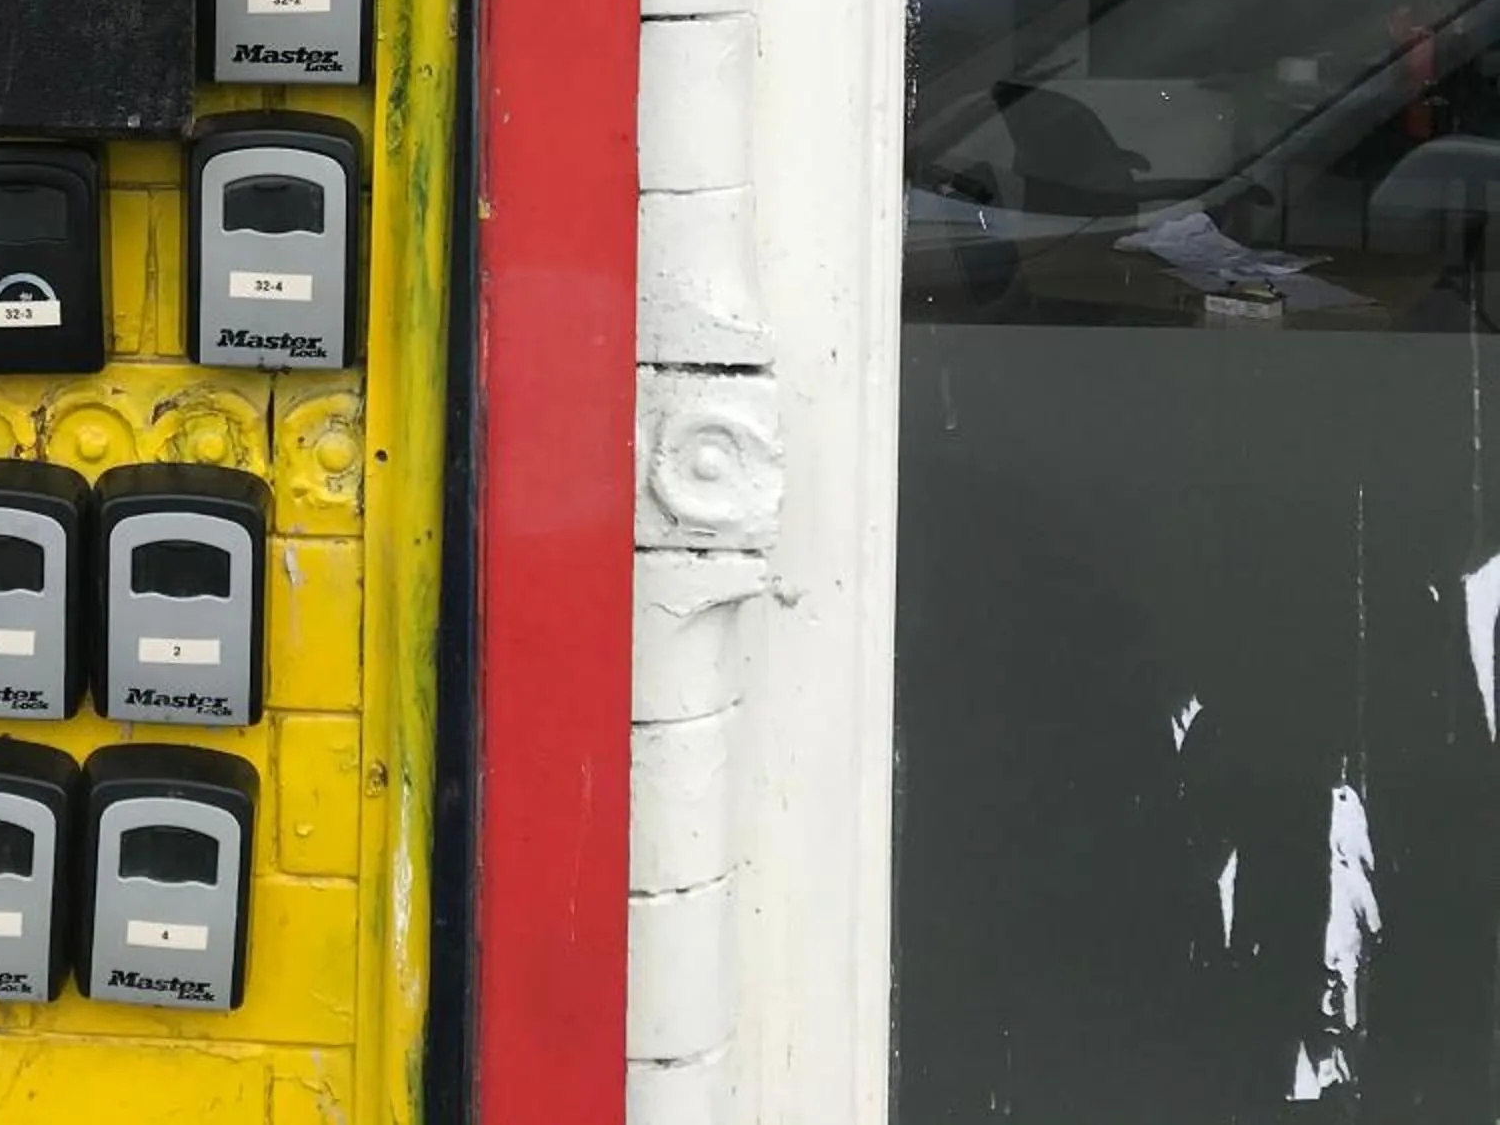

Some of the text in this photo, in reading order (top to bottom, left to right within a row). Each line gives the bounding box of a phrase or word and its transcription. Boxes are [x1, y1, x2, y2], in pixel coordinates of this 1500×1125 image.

[232, 44, 339, 64] Master
[304, 61, 343, 72] Lock
[255, 280, 283, 292] 32-4
[5, 308, 33, 320] 32-3
[216, 328, 323, 350] Master
[289, 346, 328, 358] Lock
[173, 646, 181, 656] 2
[11, 698, 49, 710] Lock
[125, 687, 229, 709] Master
[197, 705, 233, 716] Lock
[162, 930, 169, 940] 4
[107, 969, 212, 993] Master
[177, 989, 217, 1002] Lock
